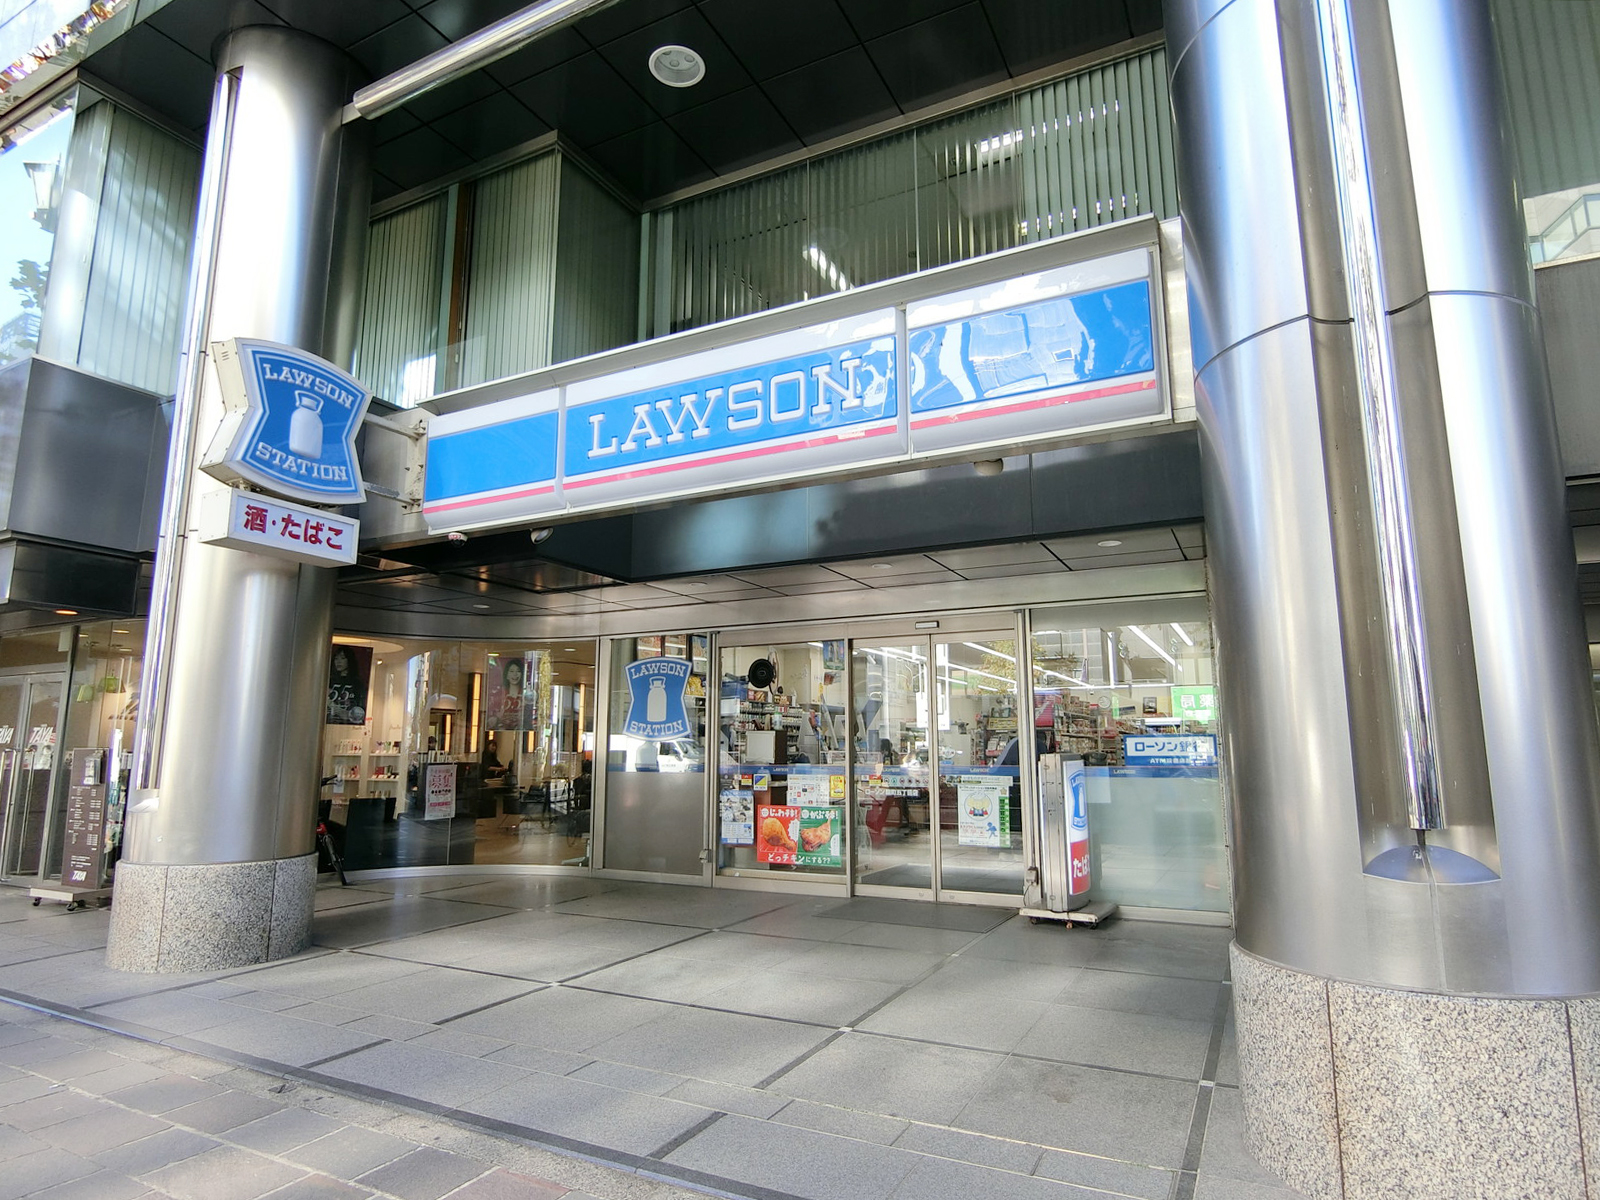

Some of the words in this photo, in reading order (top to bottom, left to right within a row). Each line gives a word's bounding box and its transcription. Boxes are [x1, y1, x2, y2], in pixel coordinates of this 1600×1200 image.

[262, 363, 355, 410] LAWSON
[588, 357, 863, 459] LAWSON
[255, 441, 348, 482] STATION
[630, 662, 686, 679] LAWSON
[629, 720, 683, 736] STATION
